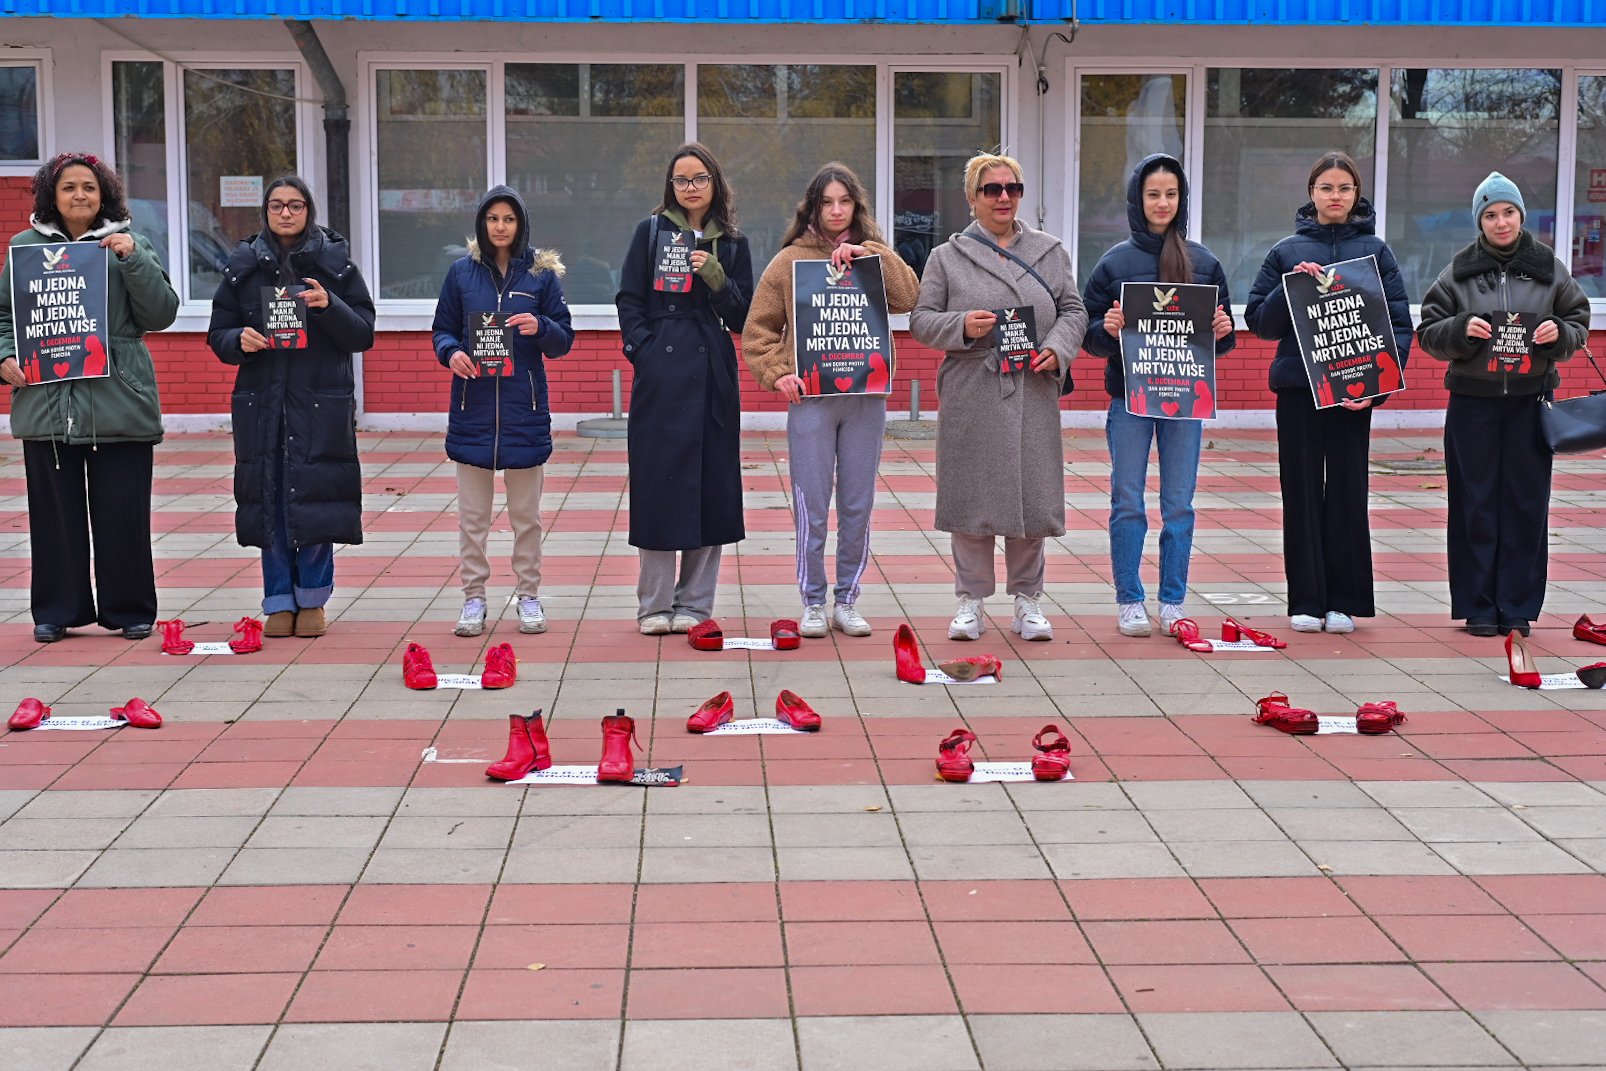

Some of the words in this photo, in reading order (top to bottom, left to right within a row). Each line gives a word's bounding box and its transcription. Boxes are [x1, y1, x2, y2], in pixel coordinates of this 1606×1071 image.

[30, 280, 42, 293] NI
[45, 276, 86, 292] JEDNA
[37, 291, 80, 307] MANJE
[812, 294, 825, 307] NI
[828, 294, 868, 307] JEDNA
[31, 309, 43, 323] NI
[46, 305, 87, 321] JEDNA
[1307, 304, 1321, 320] NI
[1324, 294, 1365, 316] JEDNA
[820, 308, 862, 321] MANJE
[1318, 310, 1362, 332] MANJE
[26, 321, 67, 339] MRTVA
[69, 317, 97, 334] VIŠE
[813, 323, 826, 336] NI
[829, 323, 869, 336] JEDNA
[1008, 322, 1027, 330] JEDNA
[1138, 319, 1150, 333] NI
[1154, 320, 1194, 334] JEDNA
[46, 336, 81, 347] DECEMBAR
[1010, 336, 1028, 344] JEDNA
[1146, 335, 1187, 348] MANJE
[1314, 333, 1328, 348] NI
[1331, 323, 1372, 346] JEDNA
[806, 338, 850, 351] MRTVA
[852, 335, 880, 350] VIŠE
[1001, 344, 1021, 352] MRTVA
[1312, 345, 1355, 363] MRTVA
[1356, 335, 1385, 354] VIŠE
[1493, 345, 1514, 353] MRTVA
[1139, 348, 1151, 360] NI
[1155, 349, 1194, 362] JEDNA
[1132, 362, 1175, 375] MRTVA
[1179, 362, 1205, 377] VIŠE
[1336, 356, 1371, 369] DECEMBAR
[1156, 378, 1190, 386] DECEMBAR
